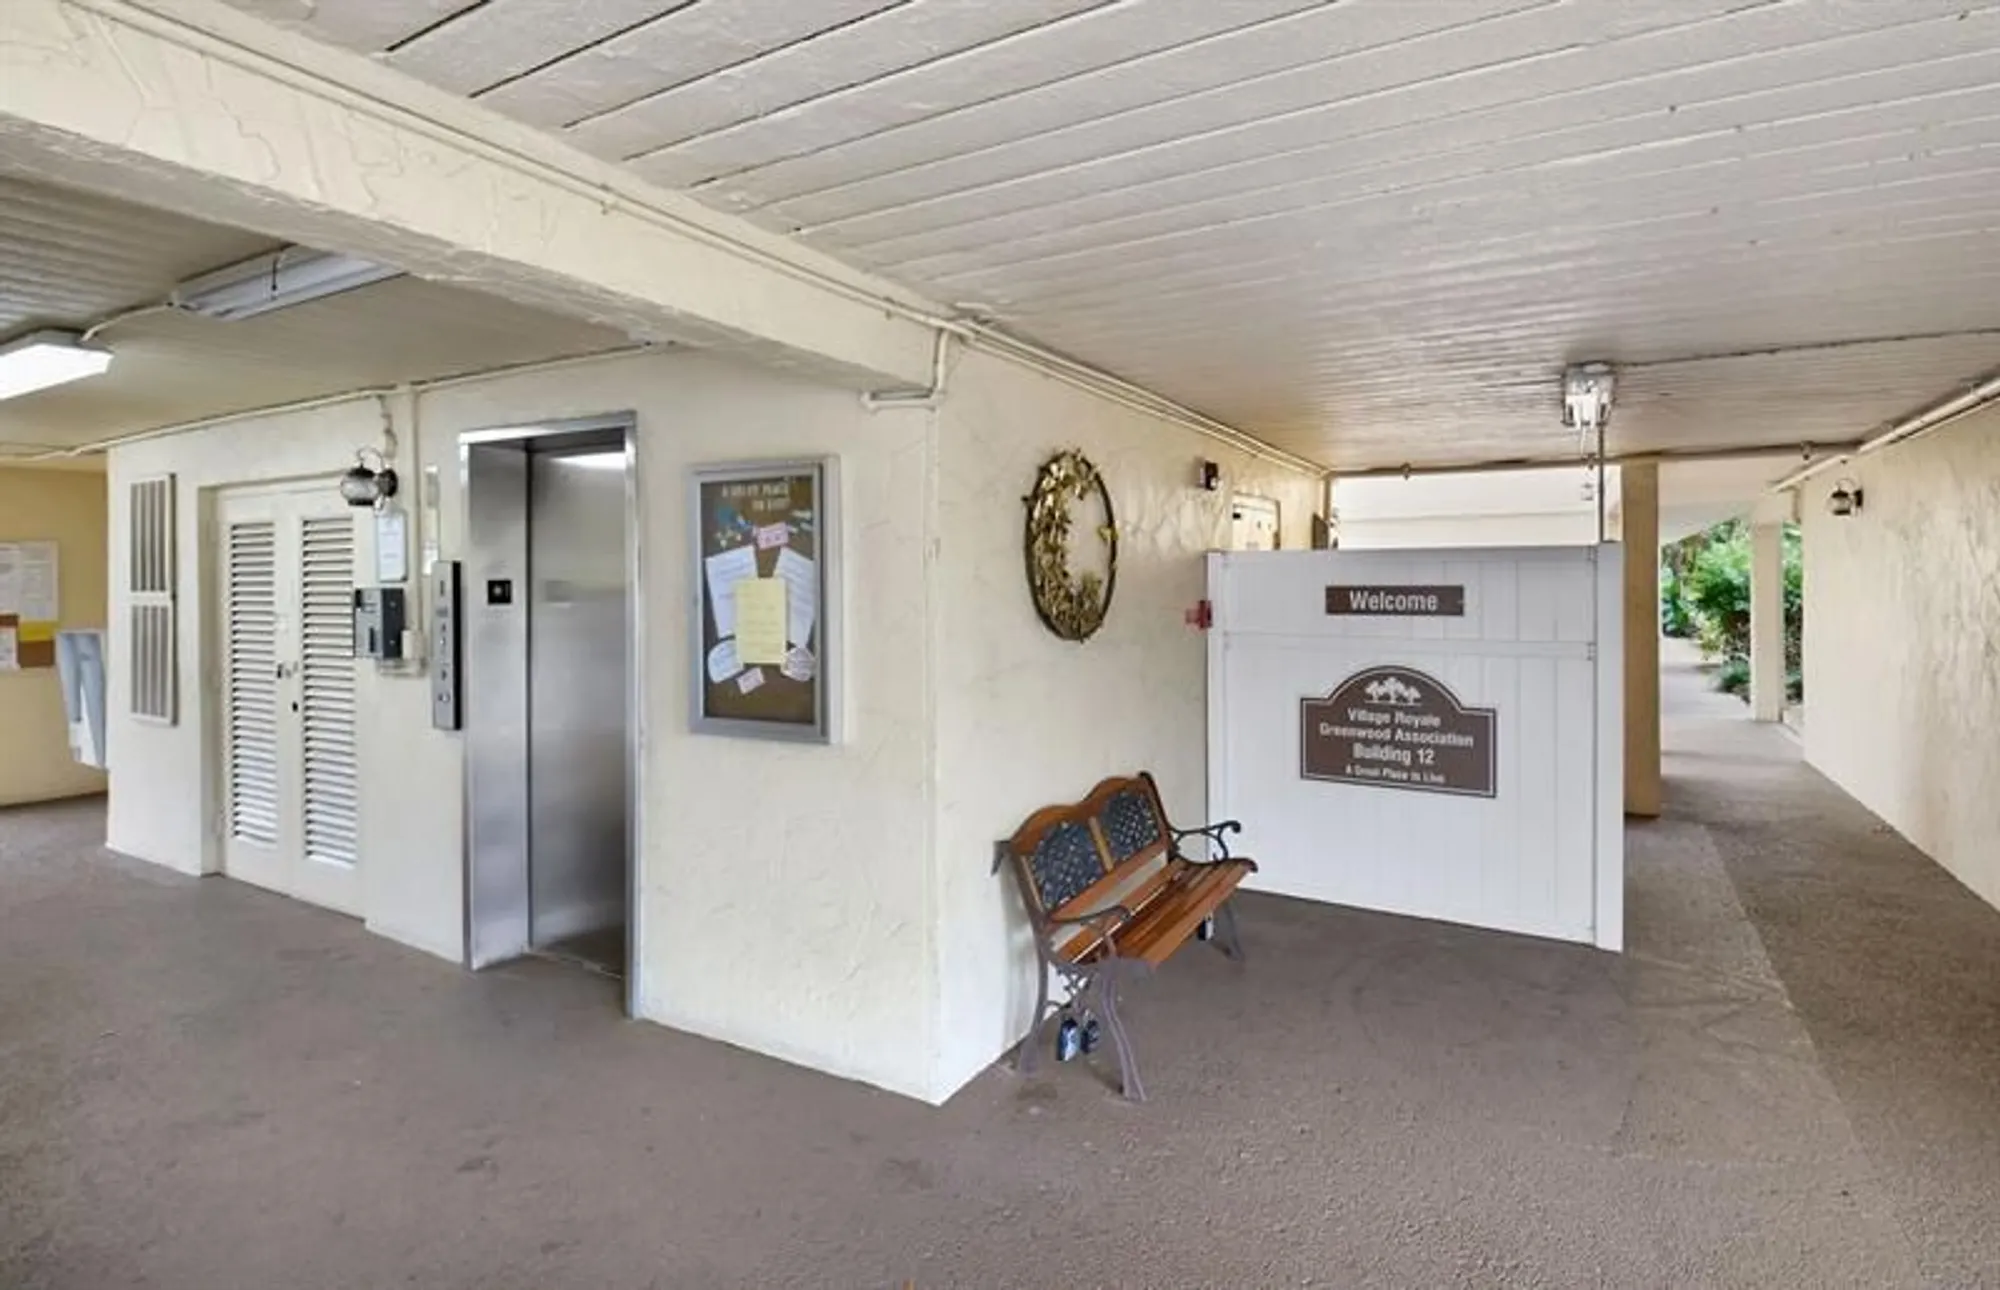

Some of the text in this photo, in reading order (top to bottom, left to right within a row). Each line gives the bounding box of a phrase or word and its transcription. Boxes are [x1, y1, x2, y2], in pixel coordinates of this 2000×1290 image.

[1350, 590, 1438, 611] Welcome
[1348, 708, 1441, 729] Village Royale
[1320, 722, 1474, 748] Greenwood Association
[1353, 743, 1435, 765] Building 12
